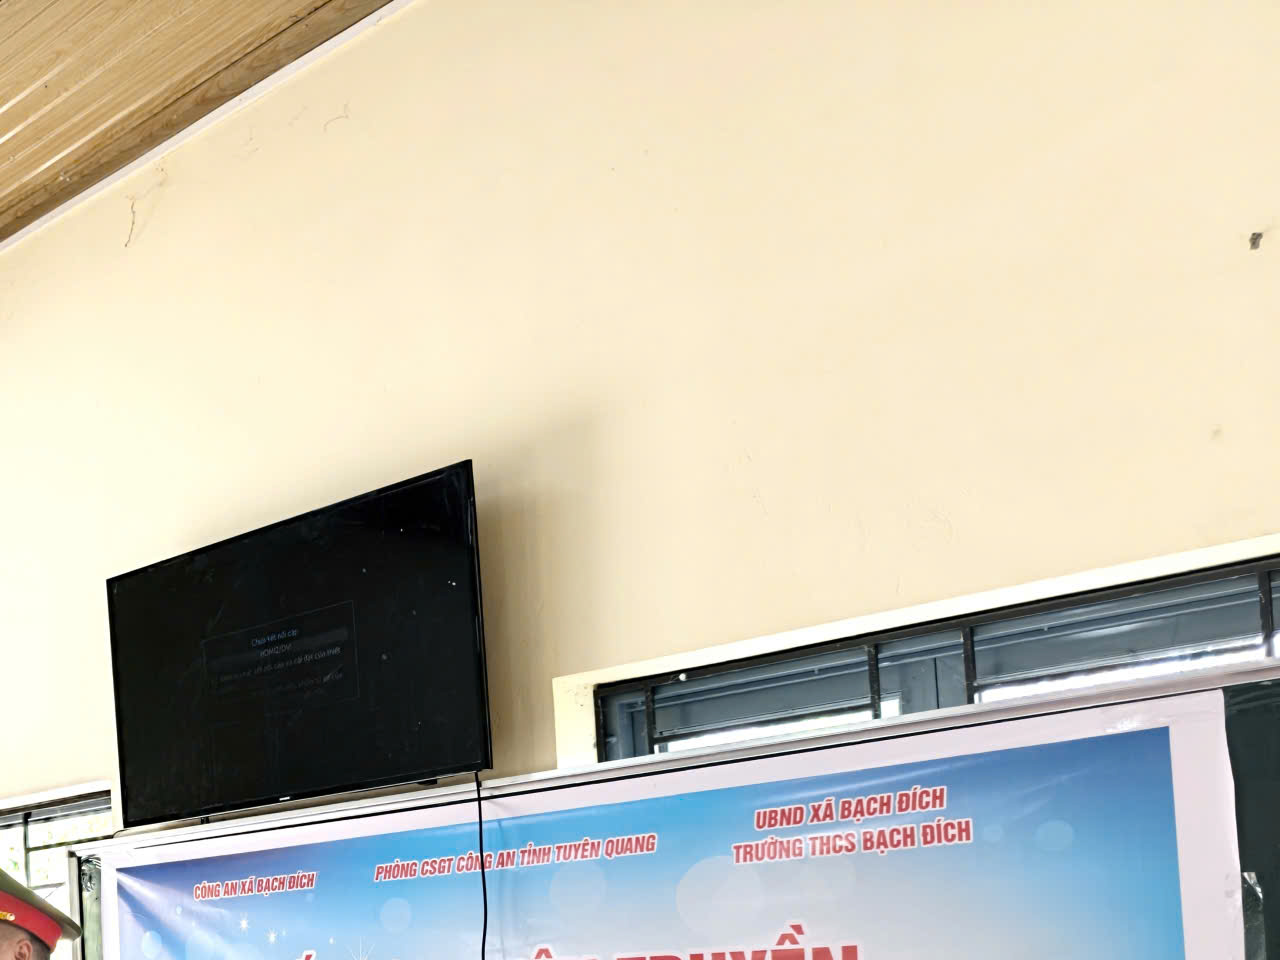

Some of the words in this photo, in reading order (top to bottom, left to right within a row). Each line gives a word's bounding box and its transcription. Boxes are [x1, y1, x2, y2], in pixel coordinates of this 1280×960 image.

[755, 806, 804, 829] UBND
[808, 799, 835, 823] XÃ
[840, 794, 891, 822] BẠCH
[897, 787, 945, 813] ĐÍCH
[375, 860, 417, 880] PHÒNG
[420, 858, 453, 876] CSGT
[456, 853, 493, 873] CÔNG
[495, 851, 515, 868] AN
[520, 843, 551, 865] TỈNH
[555, 839, 600, 861] TUYÊN
[604, 835, 656, 858] QUANG
[733, 837, 803, 863] TRƯỜNG
[809, 833, 856, 856] THCS
[863, 826, 915, 854] BẠCH
[922, 819, 971, 845] ĐÍCH
[194, 882, 220, 899] CÔNG
[223, 881, 238, 896] AN
[240, 877, 255, 895] XÃ
[256, 875, 286, 895] BẠCH
[287, 871, 315, 890] ĐÍCH
